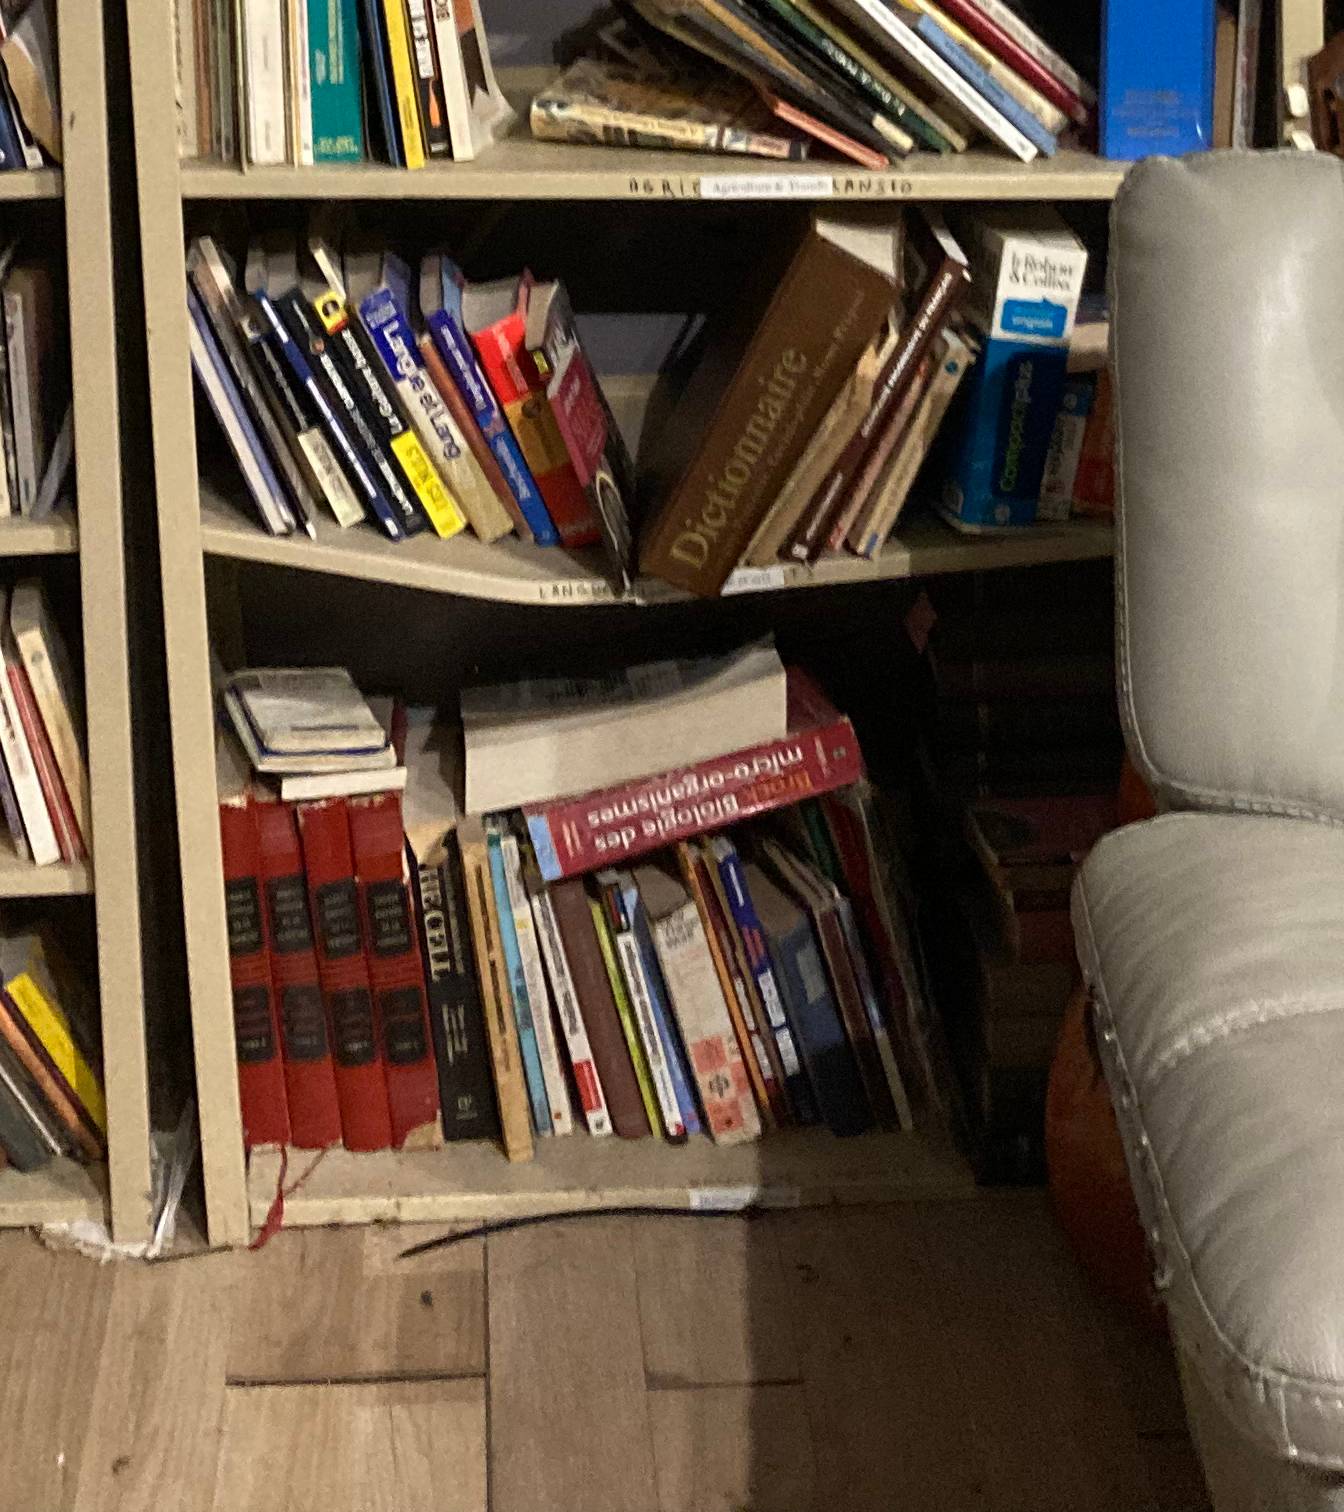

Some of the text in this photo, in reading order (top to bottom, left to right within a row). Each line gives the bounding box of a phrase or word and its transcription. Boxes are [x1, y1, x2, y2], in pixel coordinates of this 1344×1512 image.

[669, 348, 807, 571] Dictionnaire
[587, 744, 804, 829] micro-organismes
[593, 792, 740, 853] Biologie des
